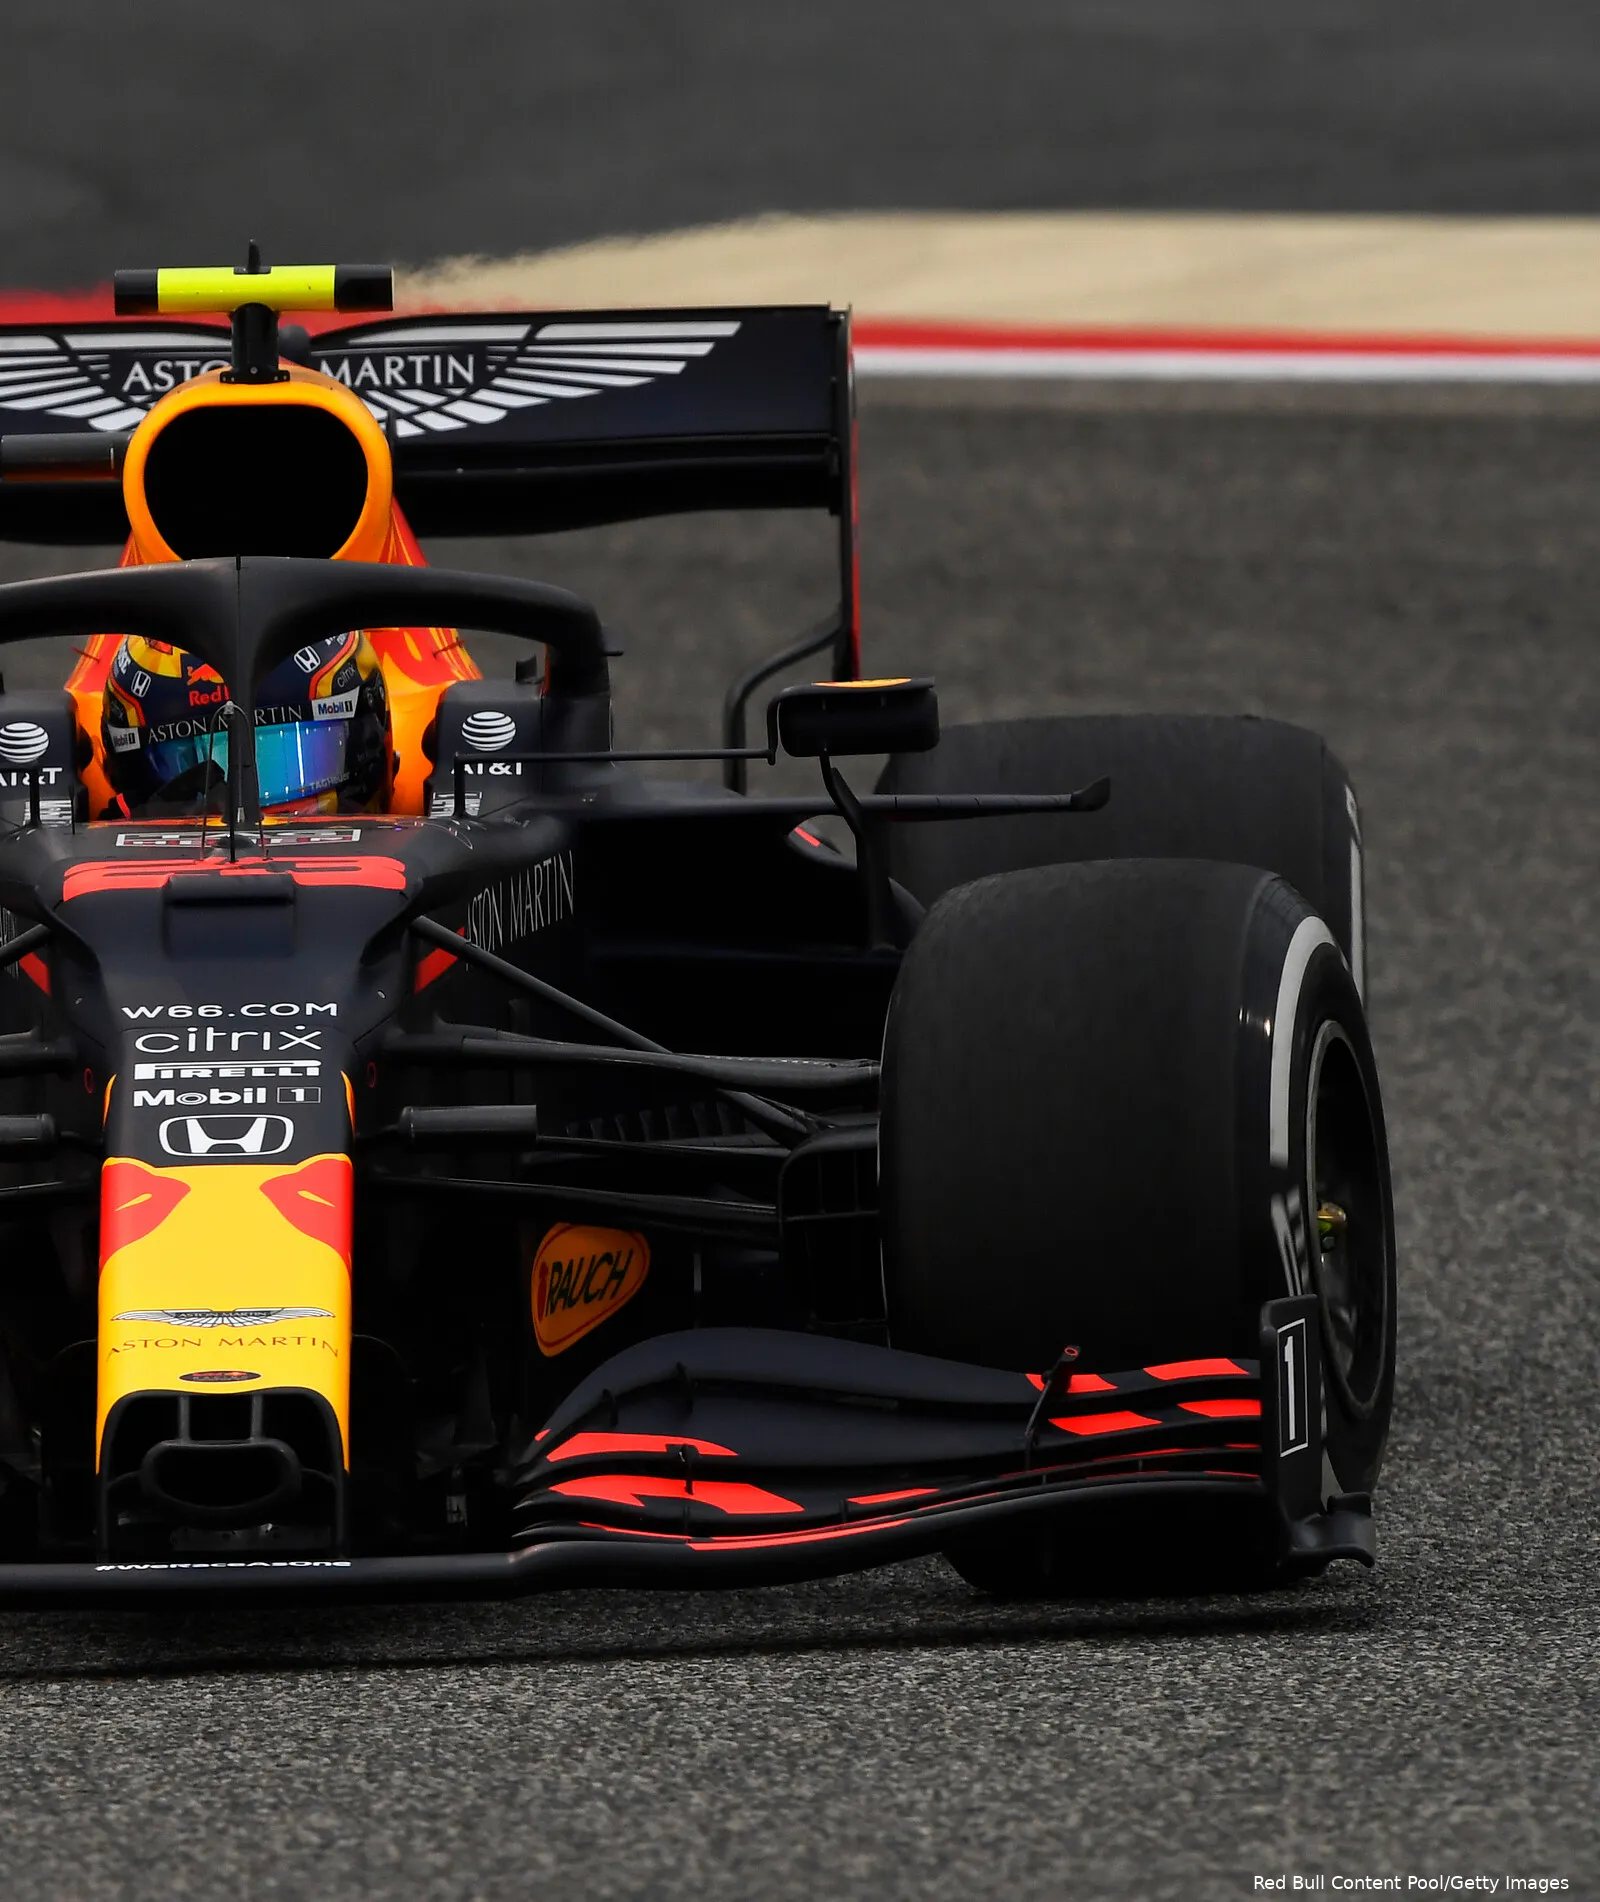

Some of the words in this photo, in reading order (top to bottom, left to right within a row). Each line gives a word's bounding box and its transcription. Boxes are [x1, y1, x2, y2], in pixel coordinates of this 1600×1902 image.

[121, 359, 232, 392] AST
[320, 354, 475, 388] MARTIN
[189, 685, 221, 707] Red
[318, 702, 344, 715] Mobil
[148, 717, 207, 744] ASTON
[218, 704, 303, 731] RTIN
[510, 850, 574, 942] MARTIN
[121, 1002, 338, 1019] W66.COM
[135, 1026, 322, 1053] citrix
[134, 1060, 322, 1080] PIRELLI
[133, 1087, 267, 1107] Mobil
[545, 1248, 634, 1317] RAUCH
[106, 1338, 202, 1362] ASTON
[218, 1336, 339, 1358] MARTIN
